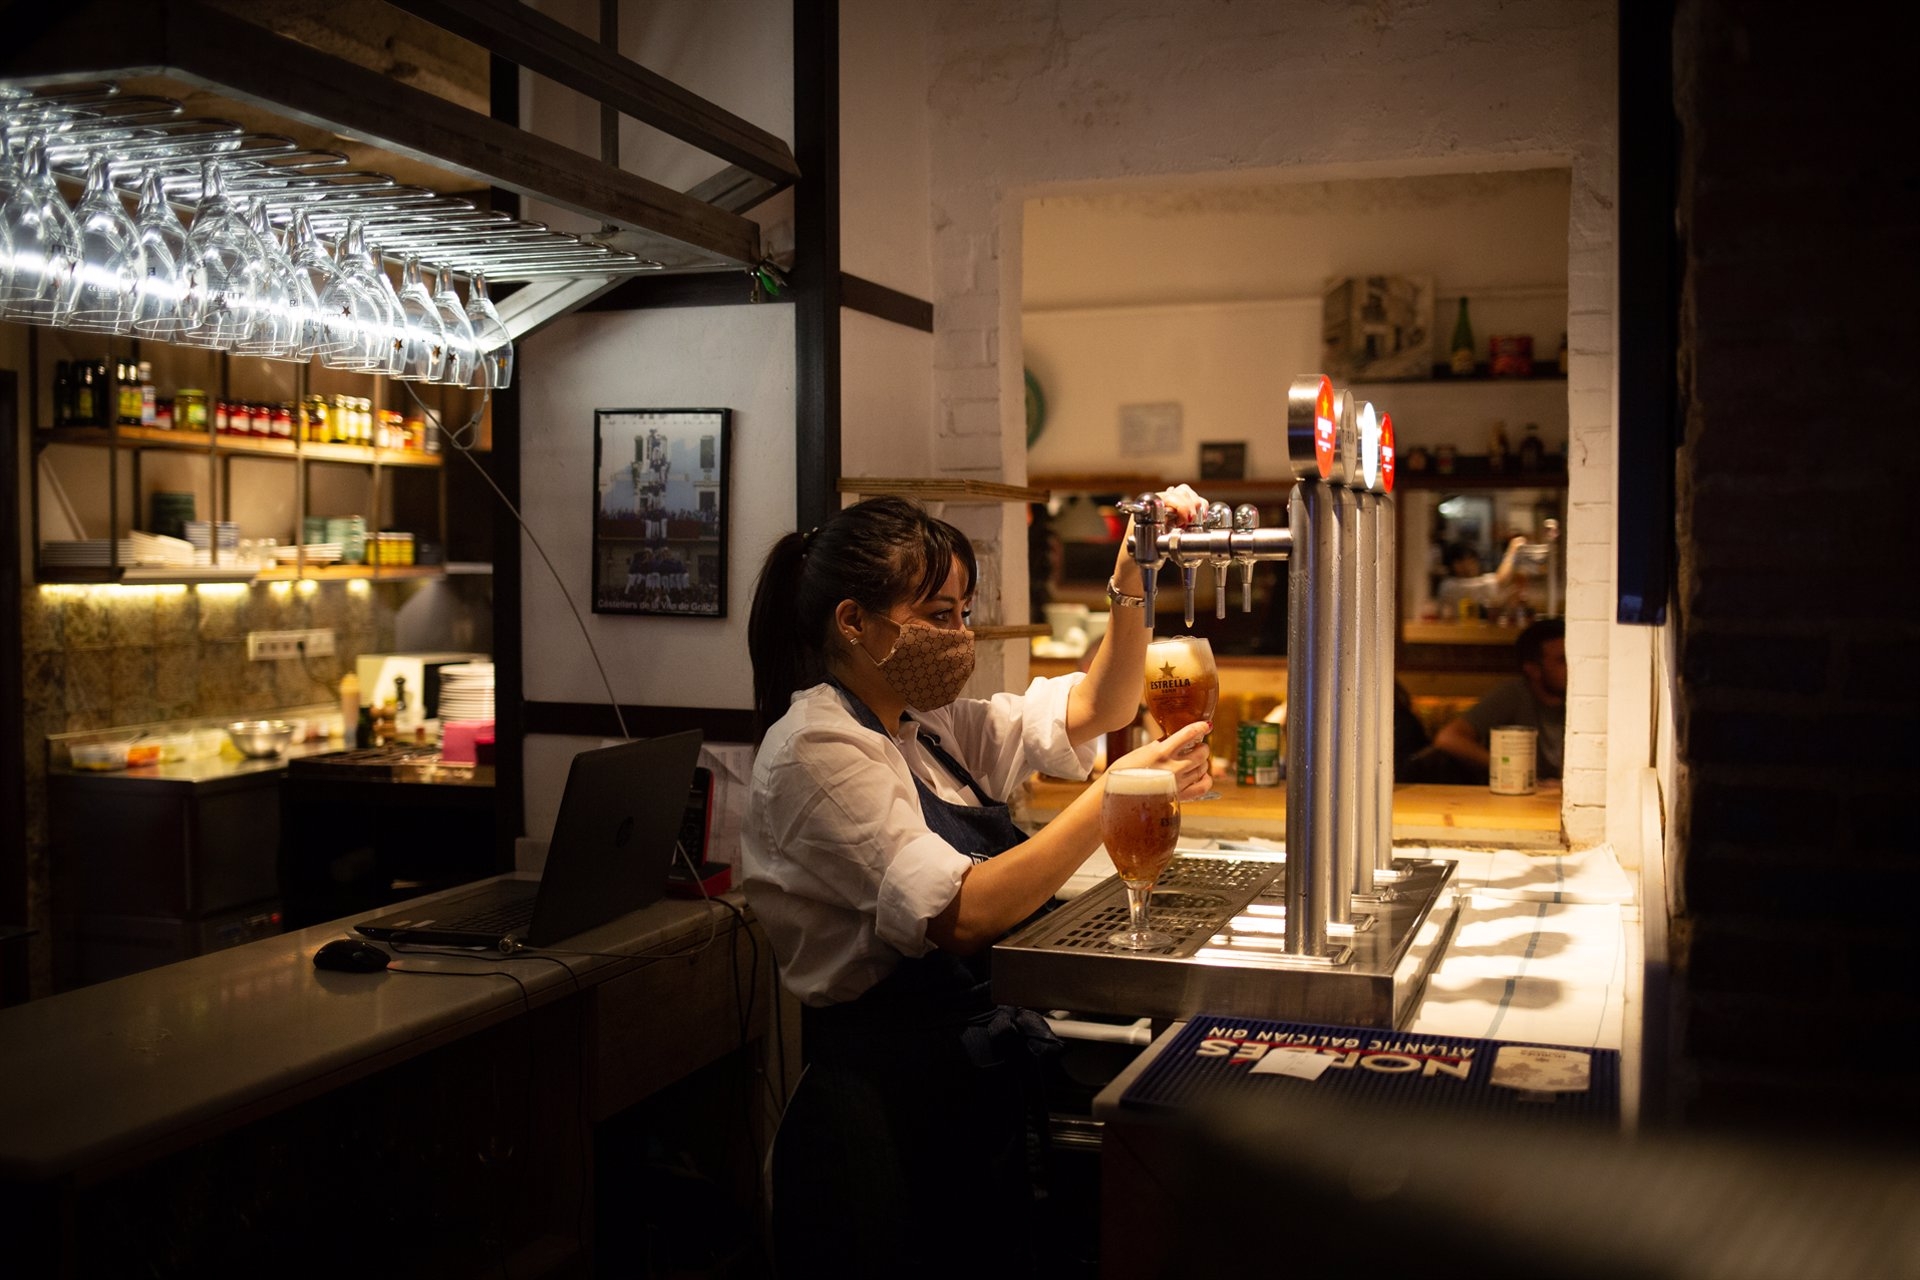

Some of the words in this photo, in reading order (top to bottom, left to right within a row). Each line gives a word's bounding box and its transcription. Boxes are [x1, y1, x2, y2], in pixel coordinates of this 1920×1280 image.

[1150, 678, 1191, 689] ESTRELLA
[1207, 1026, 1248, 1039] GIN
[1257, 1030, 1361, 1050] GALICIAN
[1368, 1039, 1476, 1059] ATLANTIC
